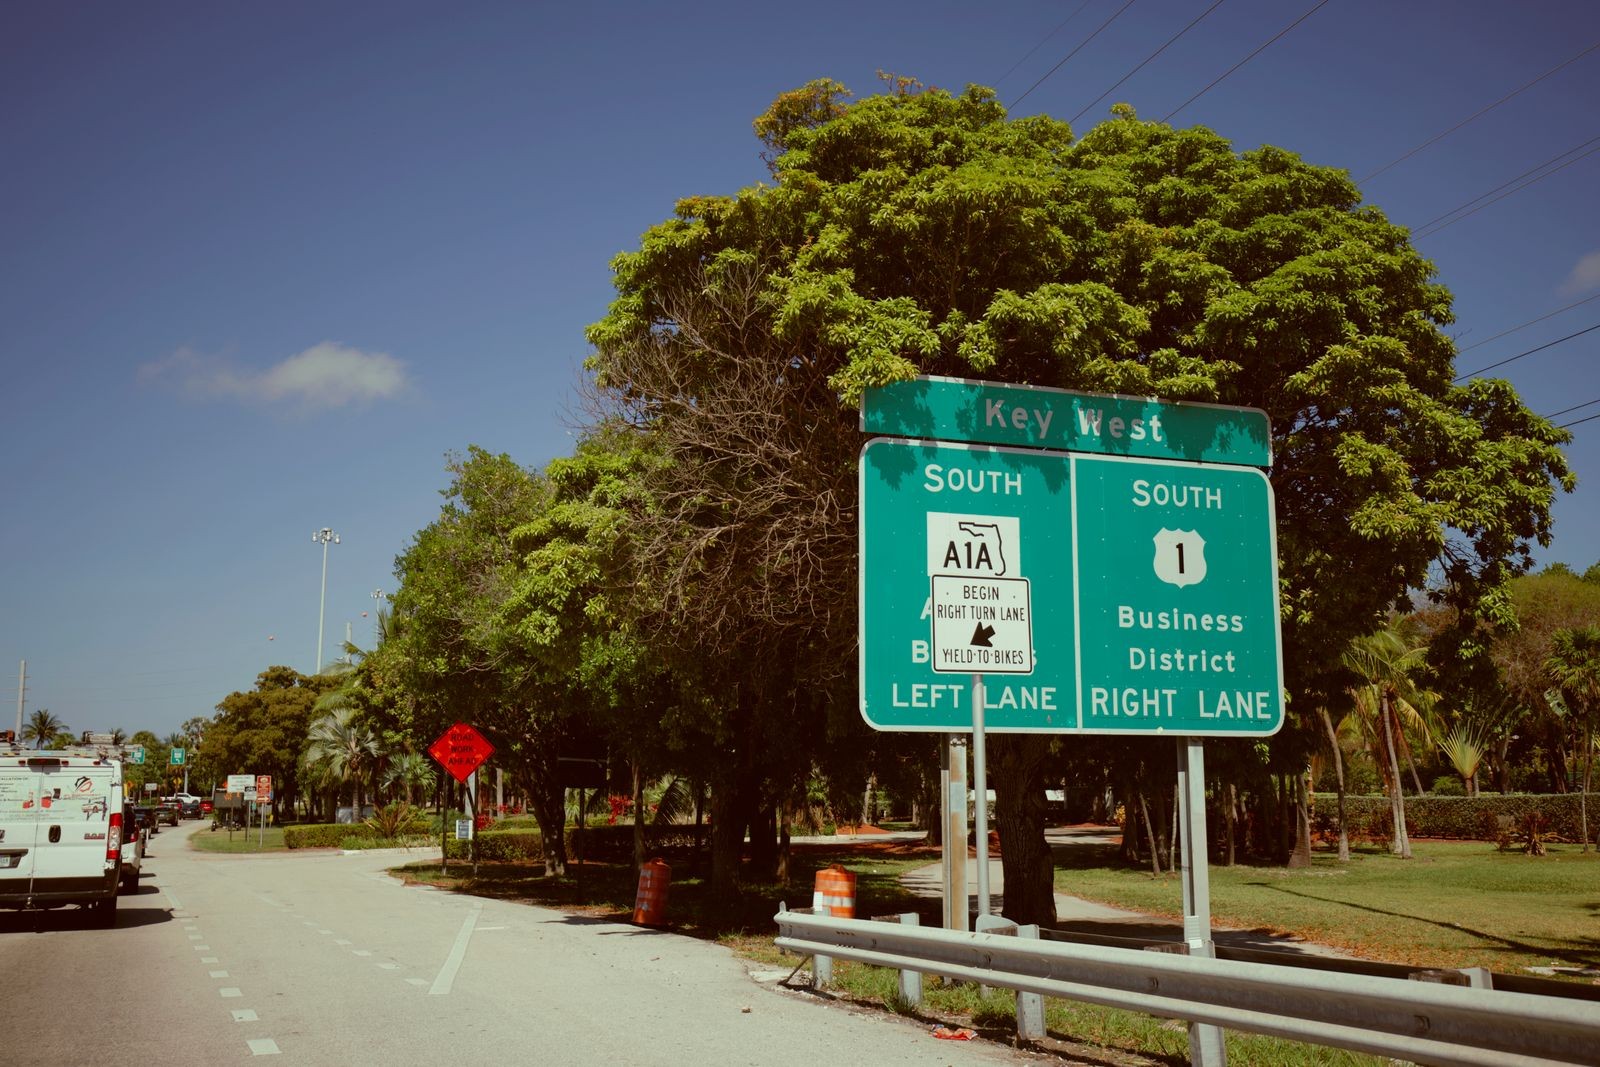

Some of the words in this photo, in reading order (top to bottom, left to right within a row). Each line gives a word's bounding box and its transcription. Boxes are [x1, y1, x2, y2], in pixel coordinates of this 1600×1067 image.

[984, 399, 1054, 439] Key
[1078, 406, 1163, 443] West
[923, 463, 1022, 496] SOUTH
[1132, 479, 1222, 510] SOUTH
[942, 540, 993, 570] A1A
[1176, 542, 1185, 574] 1
[963, 585, 999, 600] BEGIN
[937, 604, 967, 619] RIGHT
[970, 605, 996, 620] TURN
[1000, 606, 1026, 621] LANE
[1118, 605, 1244, 633] Business
[942, 648, 973, 664] YIELD
[977, 649, 990, 664] TO
[994, 650, 1024, 665] BIKES
[1129, 647, 1236, 673] District
[892, 683, 964, 708] LEFT
[983, 686, 1057, 711] LANE
[1091, 687, 1177, 717] RIGHT
[1199, 690, 1272, 719] LANE
